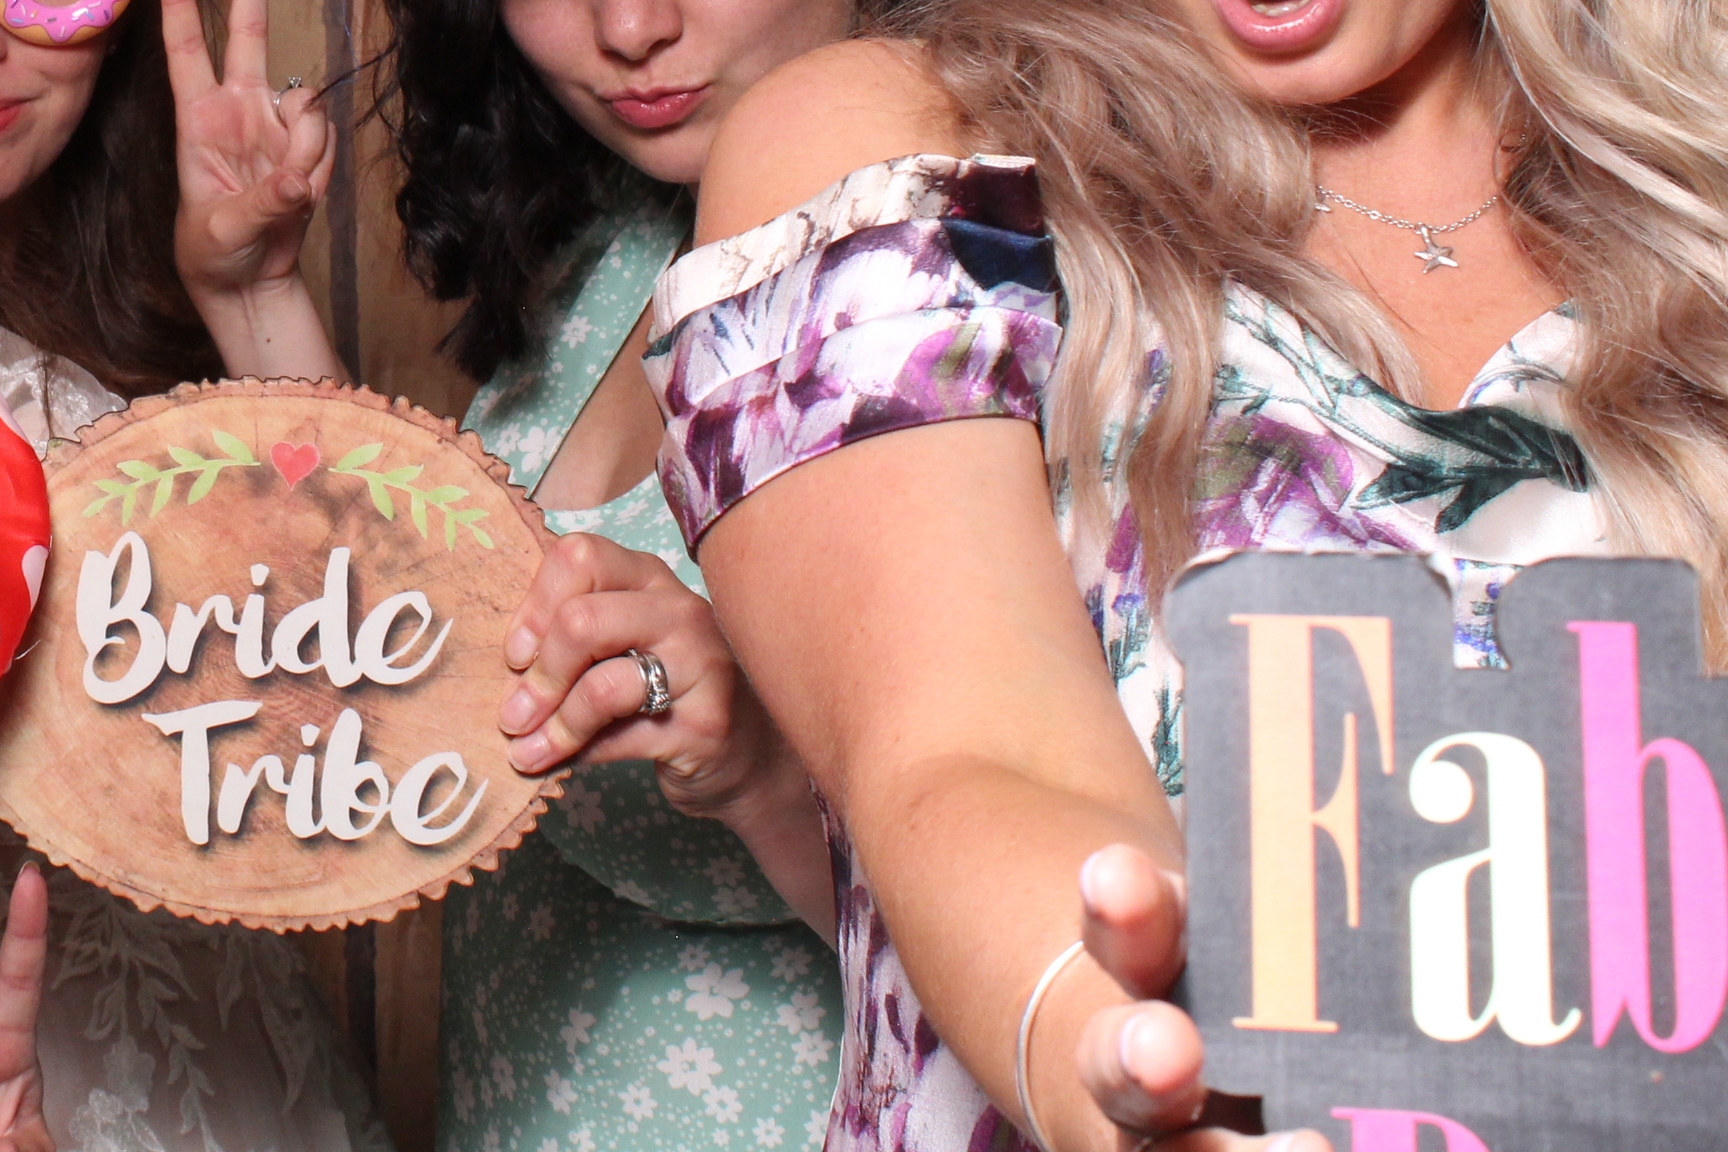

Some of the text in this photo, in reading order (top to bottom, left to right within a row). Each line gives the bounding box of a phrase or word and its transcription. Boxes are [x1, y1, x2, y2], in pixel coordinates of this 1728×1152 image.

[76, 531, 453, 704] Bride
[142, 699, 488, 846] Tribe
[1228, 614, 1728, 1054] Fab
